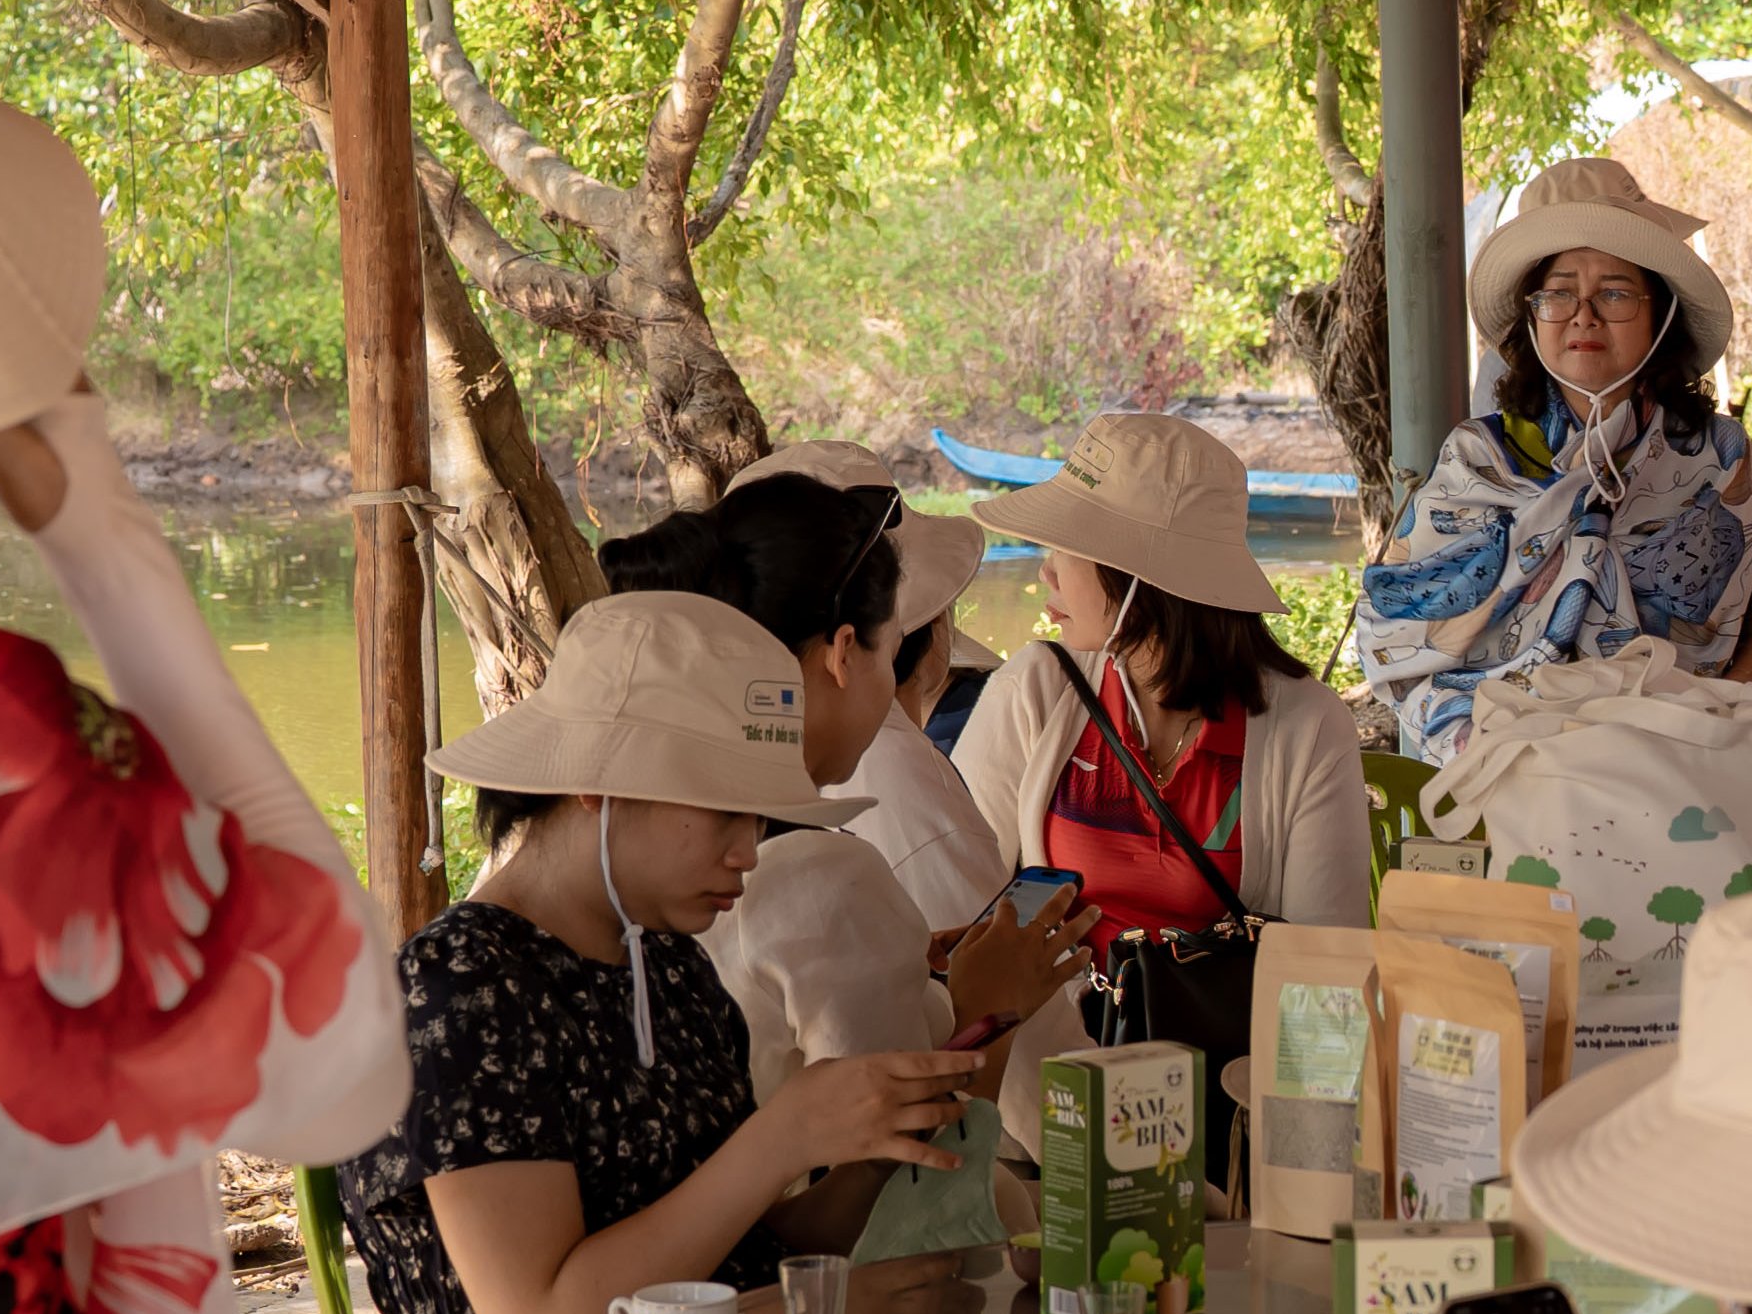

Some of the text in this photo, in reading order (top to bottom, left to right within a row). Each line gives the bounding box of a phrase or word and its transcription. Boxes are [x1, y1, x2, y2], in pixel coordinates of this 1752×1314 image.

[1613, 1026, 1641, 1034] trong
[1643, 1023, 1664, 1034] việc
[1589, 1039, 1602, 1050] hệ
[1605, 1040, 1625, 1048] sinh
[1628, 1038, 1648, 1048] thái
[1048, 1090, 1075, 1107] SAM
[1118, 1096, 1165, 1123] SAM
[1379, 1281, 1449, 1305] SAM
